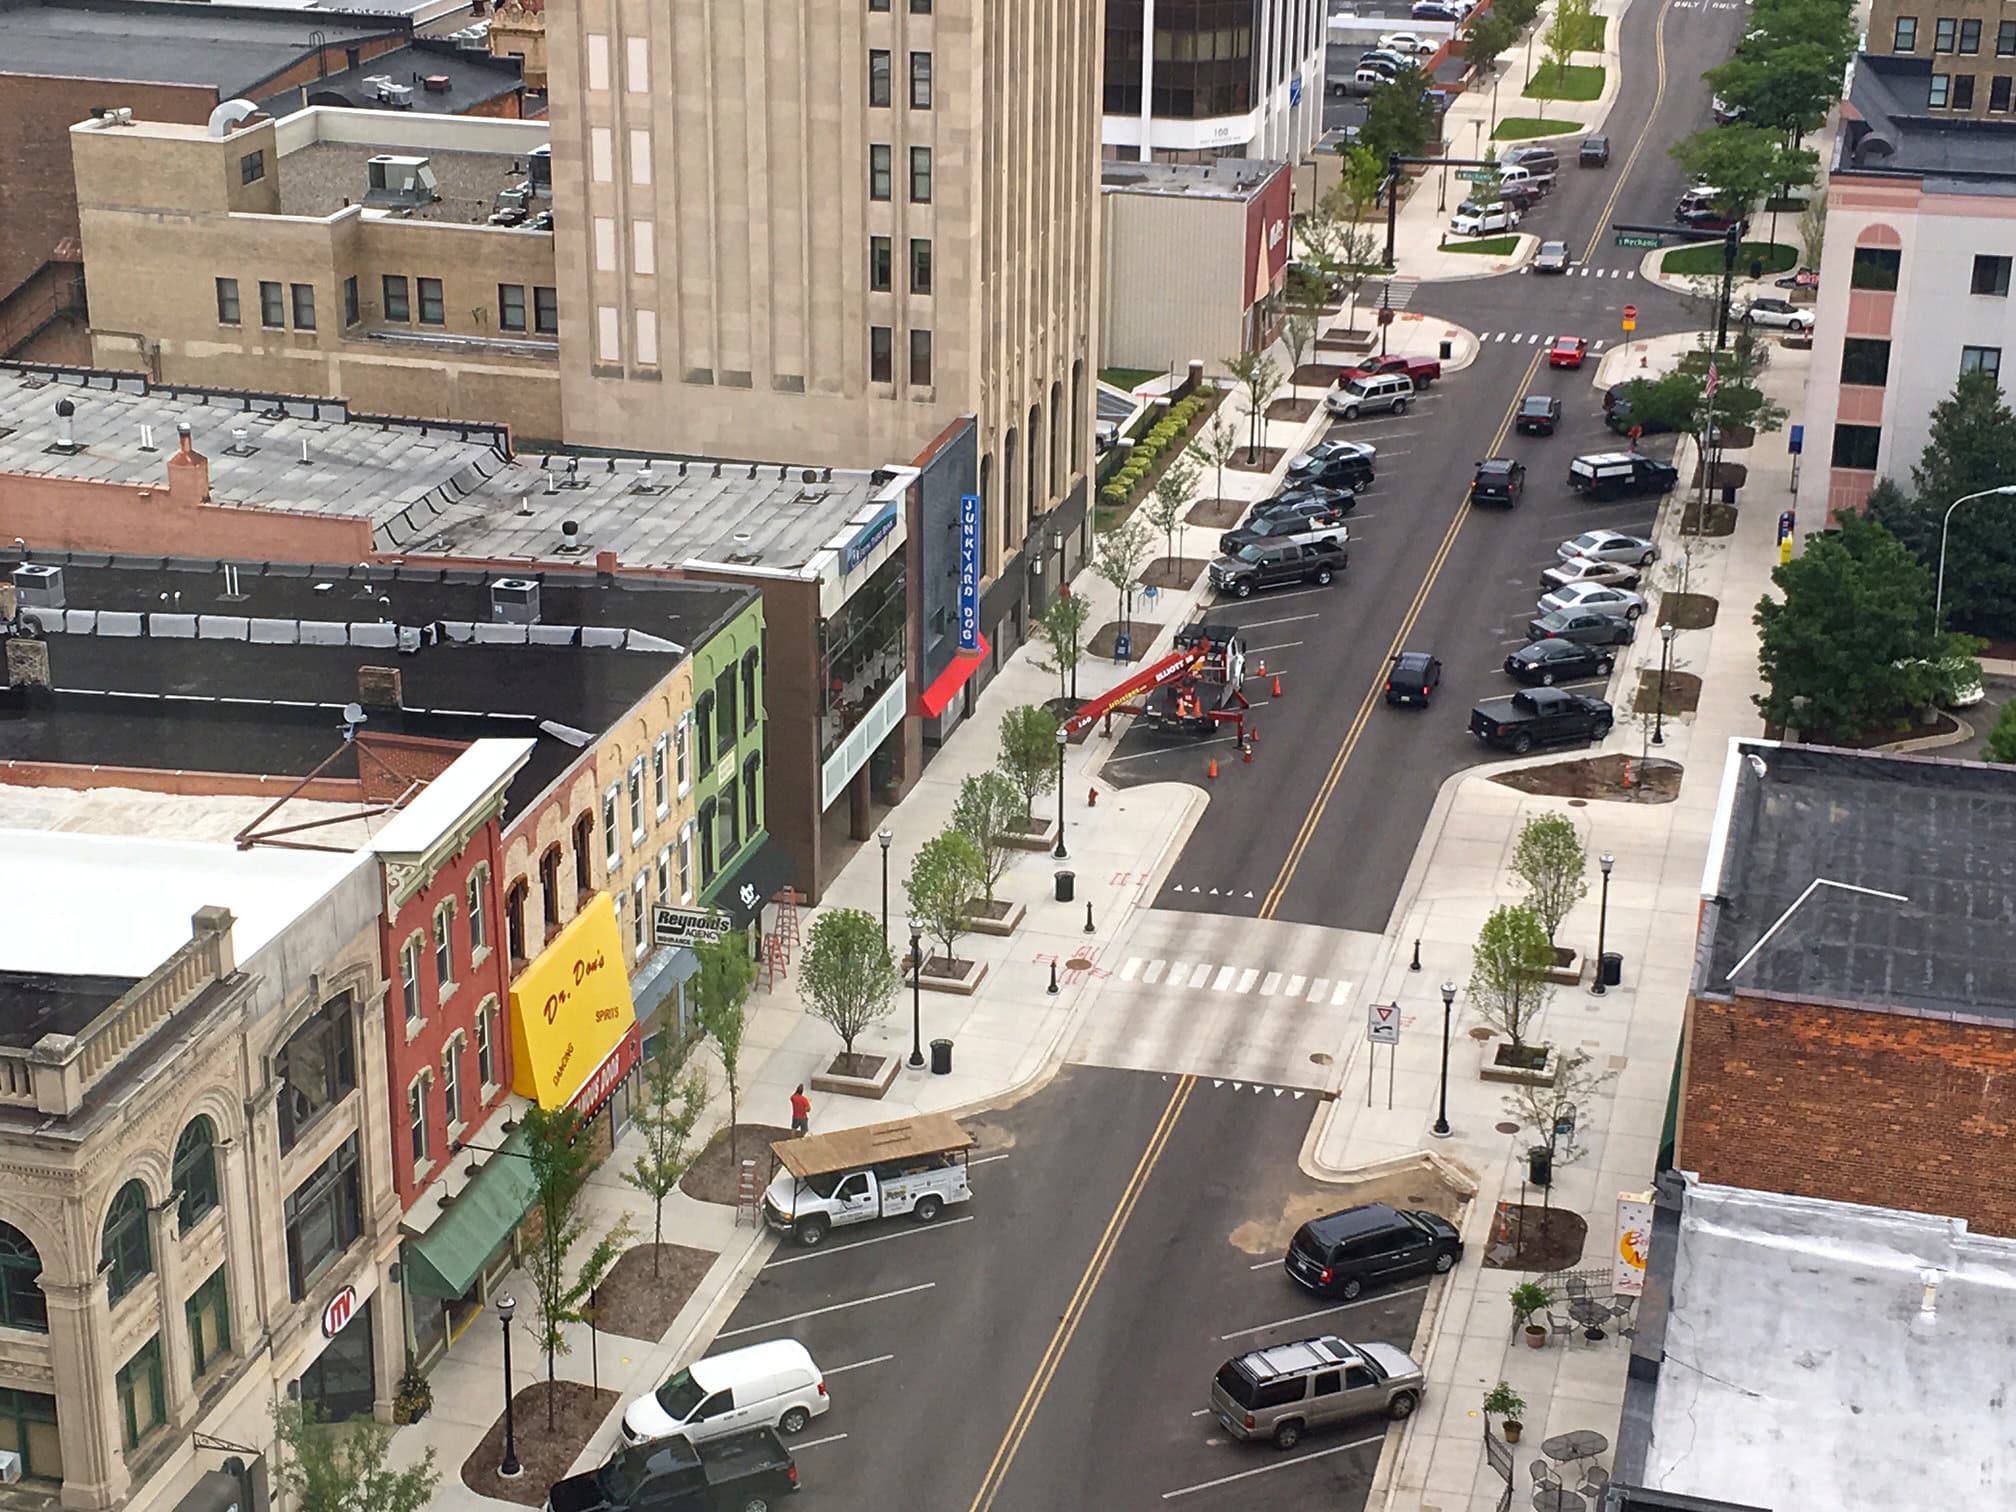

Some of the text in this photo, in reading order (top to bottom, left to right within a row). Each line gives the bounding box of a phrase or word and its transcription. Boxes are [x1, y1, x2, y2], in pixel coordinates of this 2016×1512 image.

[1214, 128, 1229, 136] 100
[1624, 238, 1659, 248] Mechanic
[962, 500, 976, 640] JUNKYARD DOG
[1155, 661, 1184, 682] ELLIOTT
[657, 910, 730, 934] Reynolds
[543, 949, 605, 1025] Dr. Don's
[594, 1006, 620, 1023] SPIRITS
[553, 1042, 574, 1087] DANCING
